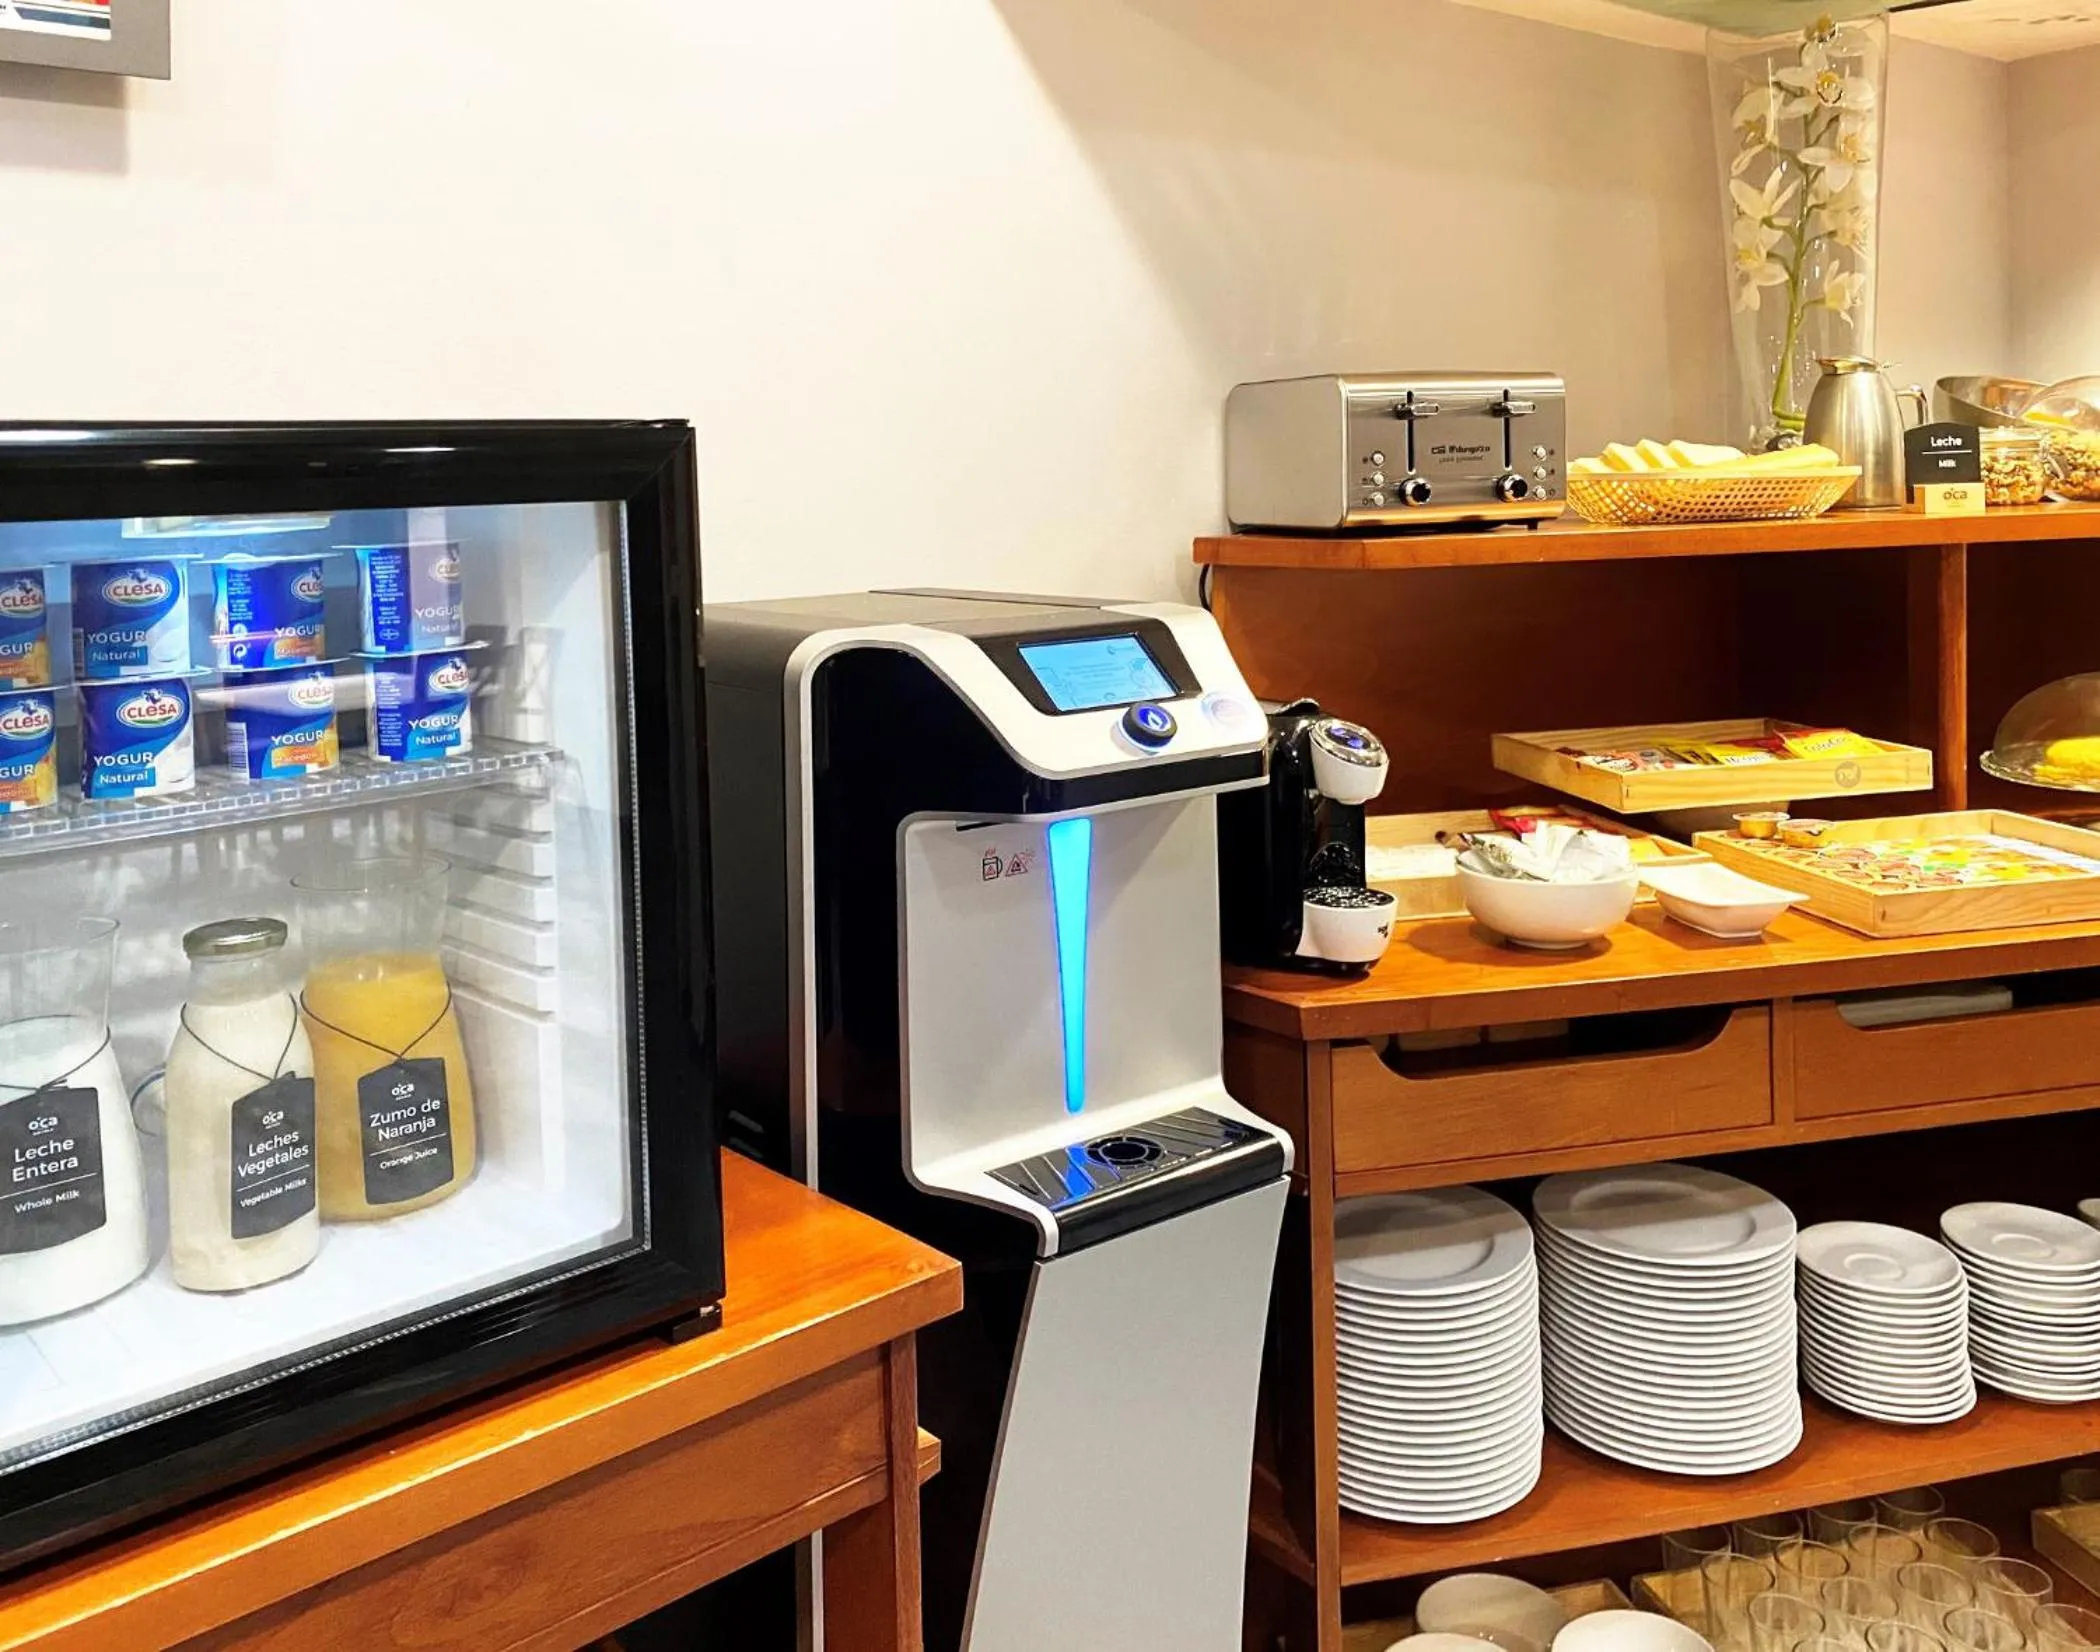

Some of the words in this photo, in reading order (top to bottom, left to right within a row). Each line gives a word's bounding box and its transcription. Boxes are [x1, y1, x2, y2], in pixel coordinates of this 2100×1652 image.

[1930, 435, 1962, 447] Leche
[1938, 458, 1957, 468] Milk
[87, 630, 147, 644] YOGUR
[92, 647, 140, 662] Natural
[408, 714, 460, 730] YOGUR
[271, 729, 324, 745] YOGUR
[415, 731, 457, 746] Natural
[94, 751, 154, 767] YOGUR
[99, 770, 148, 785] Natural
[370, 1106, 417, 1128] Zumo
[421, 1098, 441, 1113] de
[377, 1116, 437, 1142] Naranja
[14, 1138, 75, 1163] Leche
[248, 1131, 300, 1157] Leches
[237, 1144, 309, 1178] Vegetales
[380, 1154, 414, 1170] Orange
[415, 1147, 438, 1160] Juice
[12, 1156, 79, 1182] Entera
[14, 1197, 53, 1213] Whole
[55, 1189, 80, 1203] Milk
[240, 1186, 283, 1208] Vegetable
[285, 1178, 307, 1192] Milks
